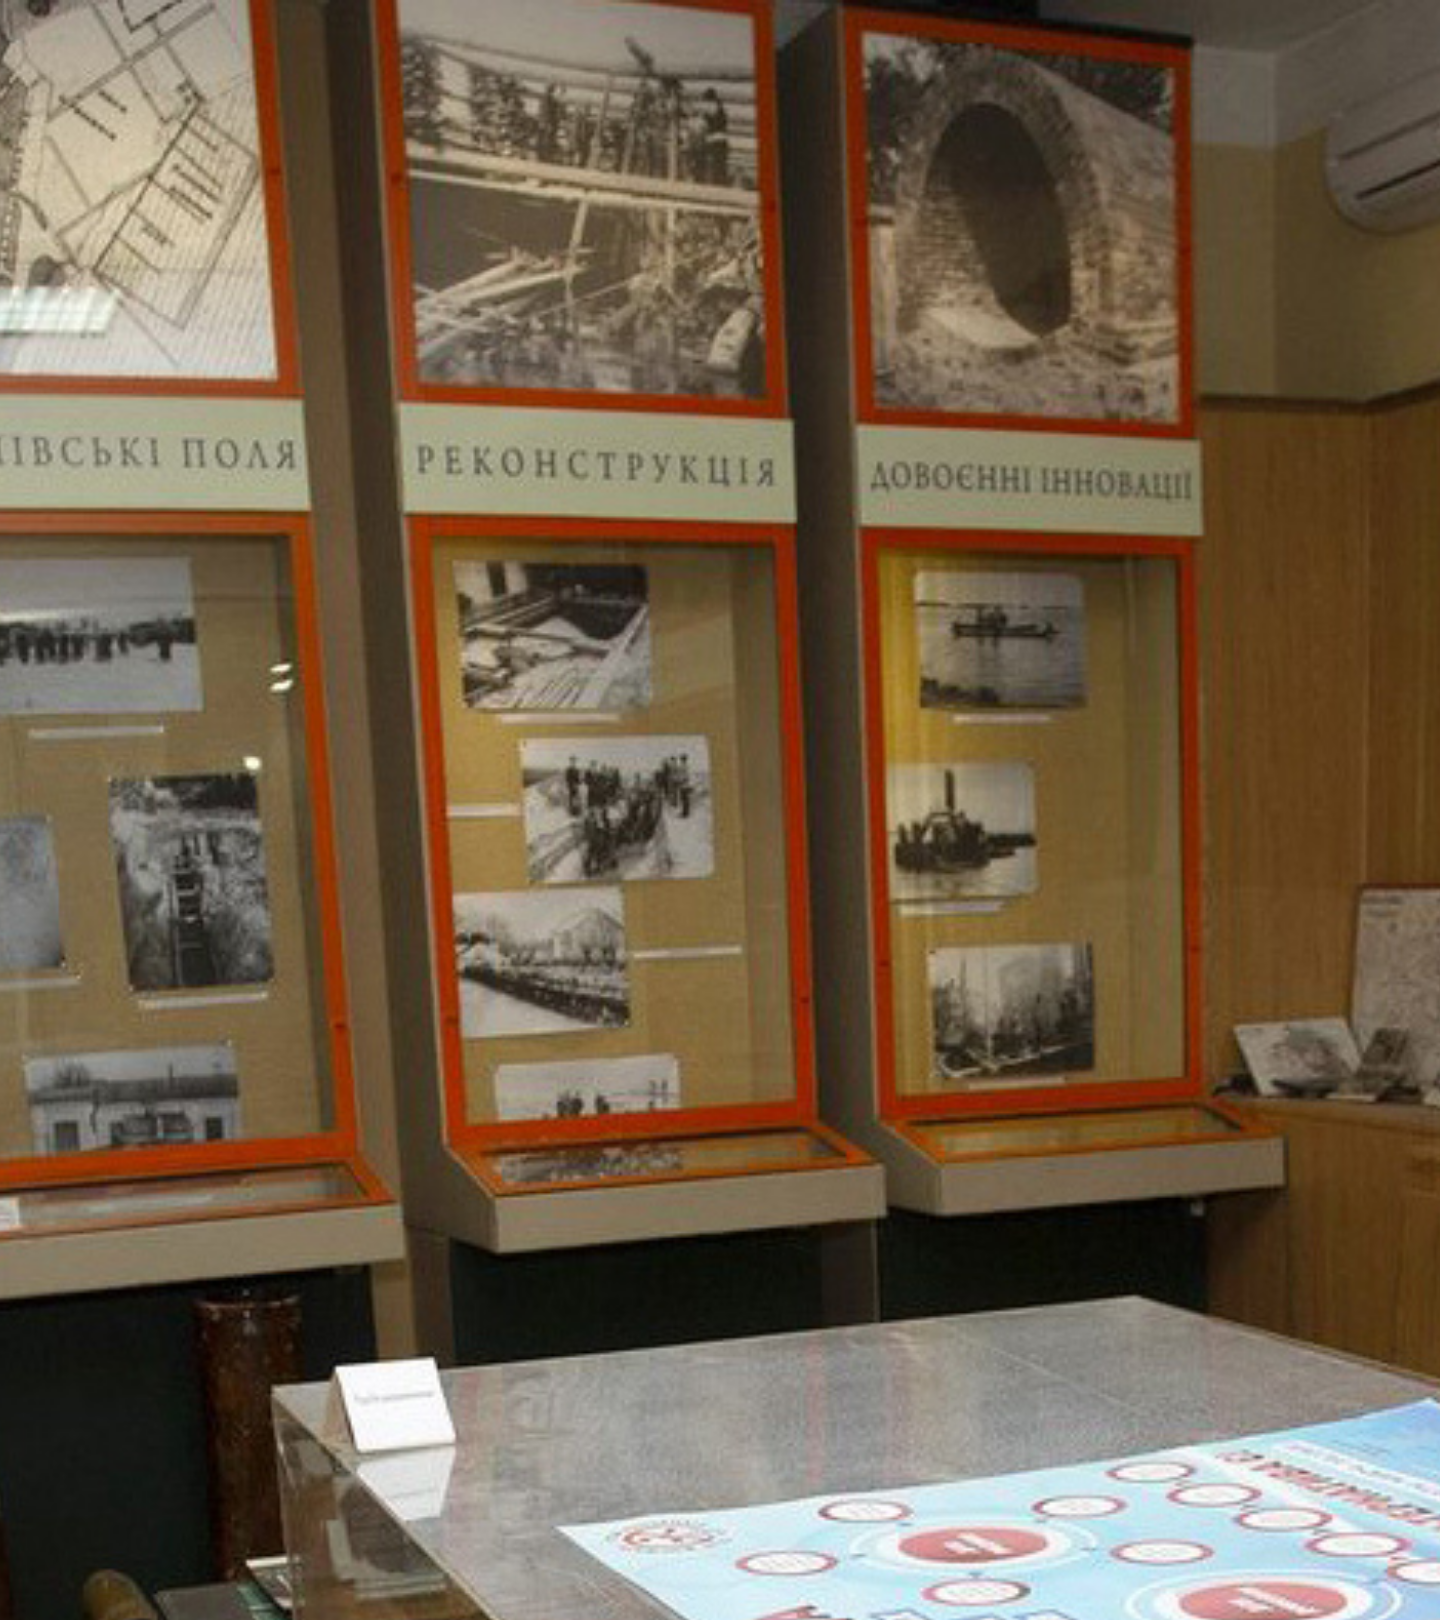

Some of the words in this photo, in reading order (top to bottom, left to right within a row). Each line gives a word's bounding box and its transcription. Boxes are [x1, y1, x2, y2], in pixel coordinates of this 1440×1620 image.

[181, 437, 299, 472] ПОЛЯ
[415, 444, 777, 488] РЕКОНСТРУКЦІЯ
[869, 459, 1033, 495] ДОВОЄННІ
[1041, 467, 1194, 502] ІННОВАЦІЇ
